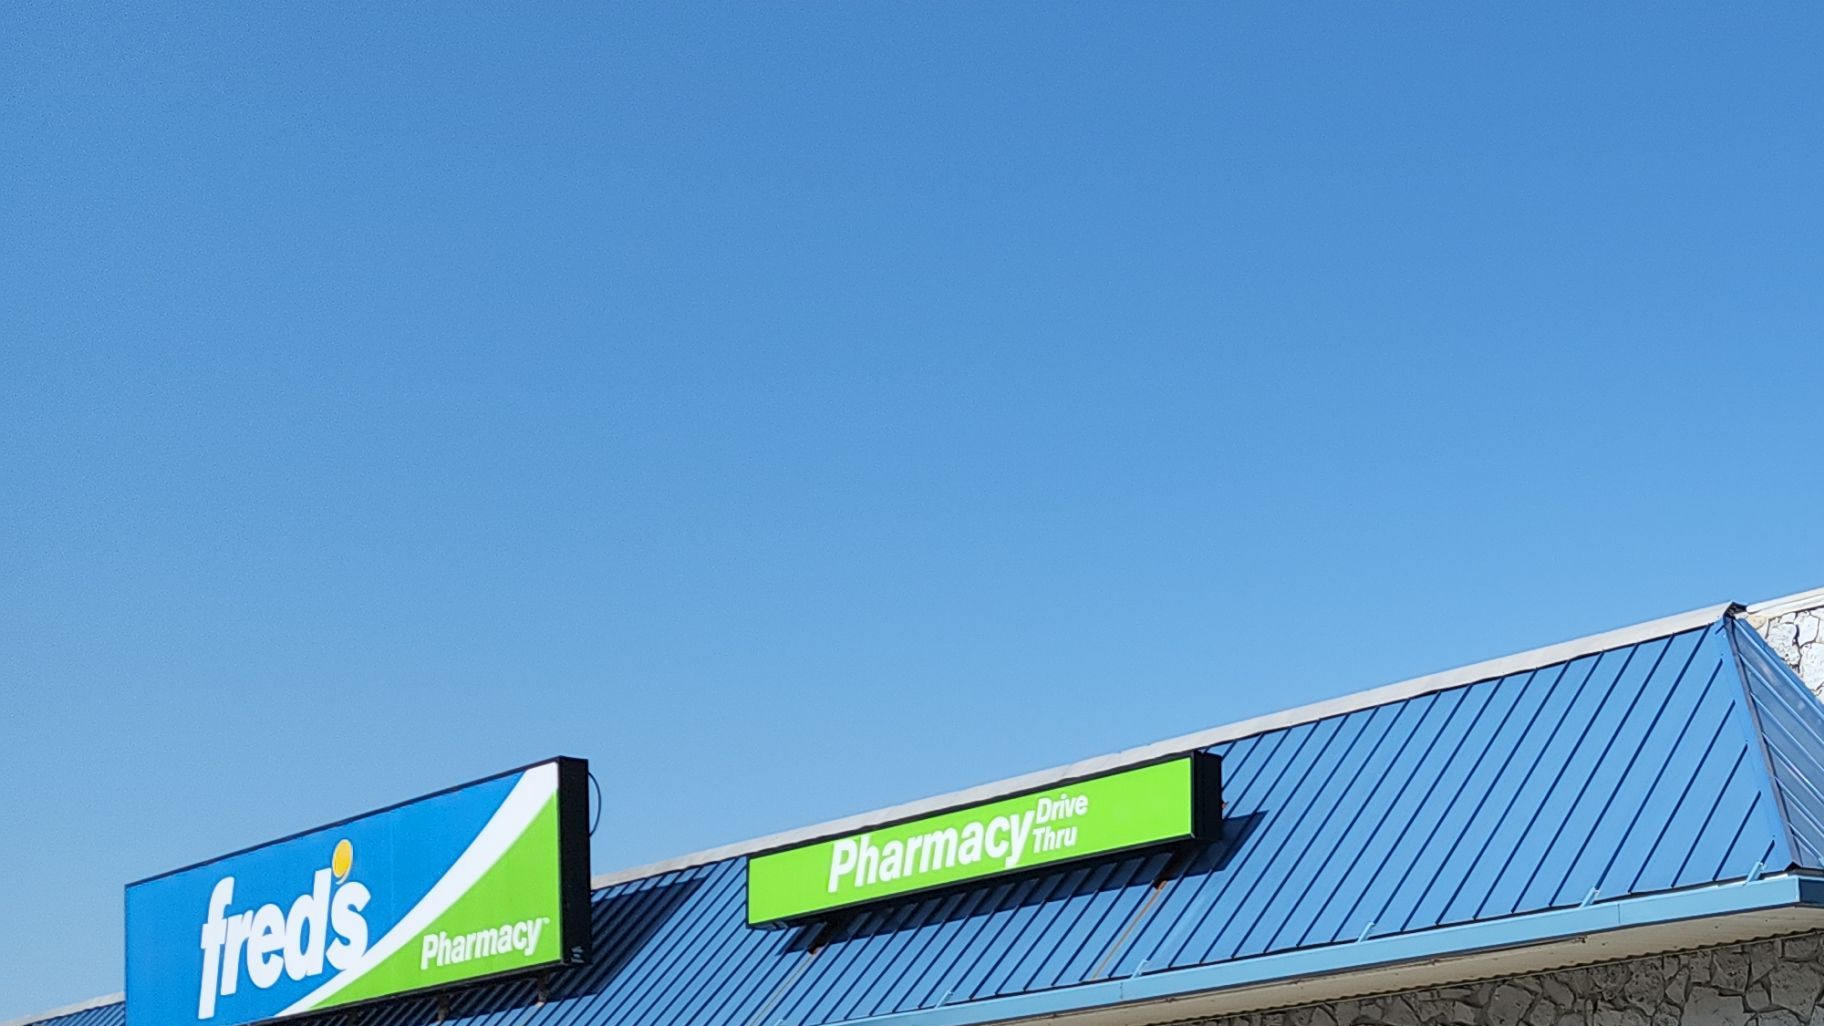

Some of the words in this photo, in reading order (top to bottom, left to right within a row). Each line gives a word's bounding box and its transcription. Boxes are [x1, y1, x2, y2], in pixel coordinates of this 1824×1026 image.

[1035, 792, 1088, 825] Drive
[828, 809, 1034, 893] Pharmacy
[1032, 825, 1077, 854] Thru
[198, 838, 371, 1020] fred's
[421, 918, 542, 969] Pharmacy
